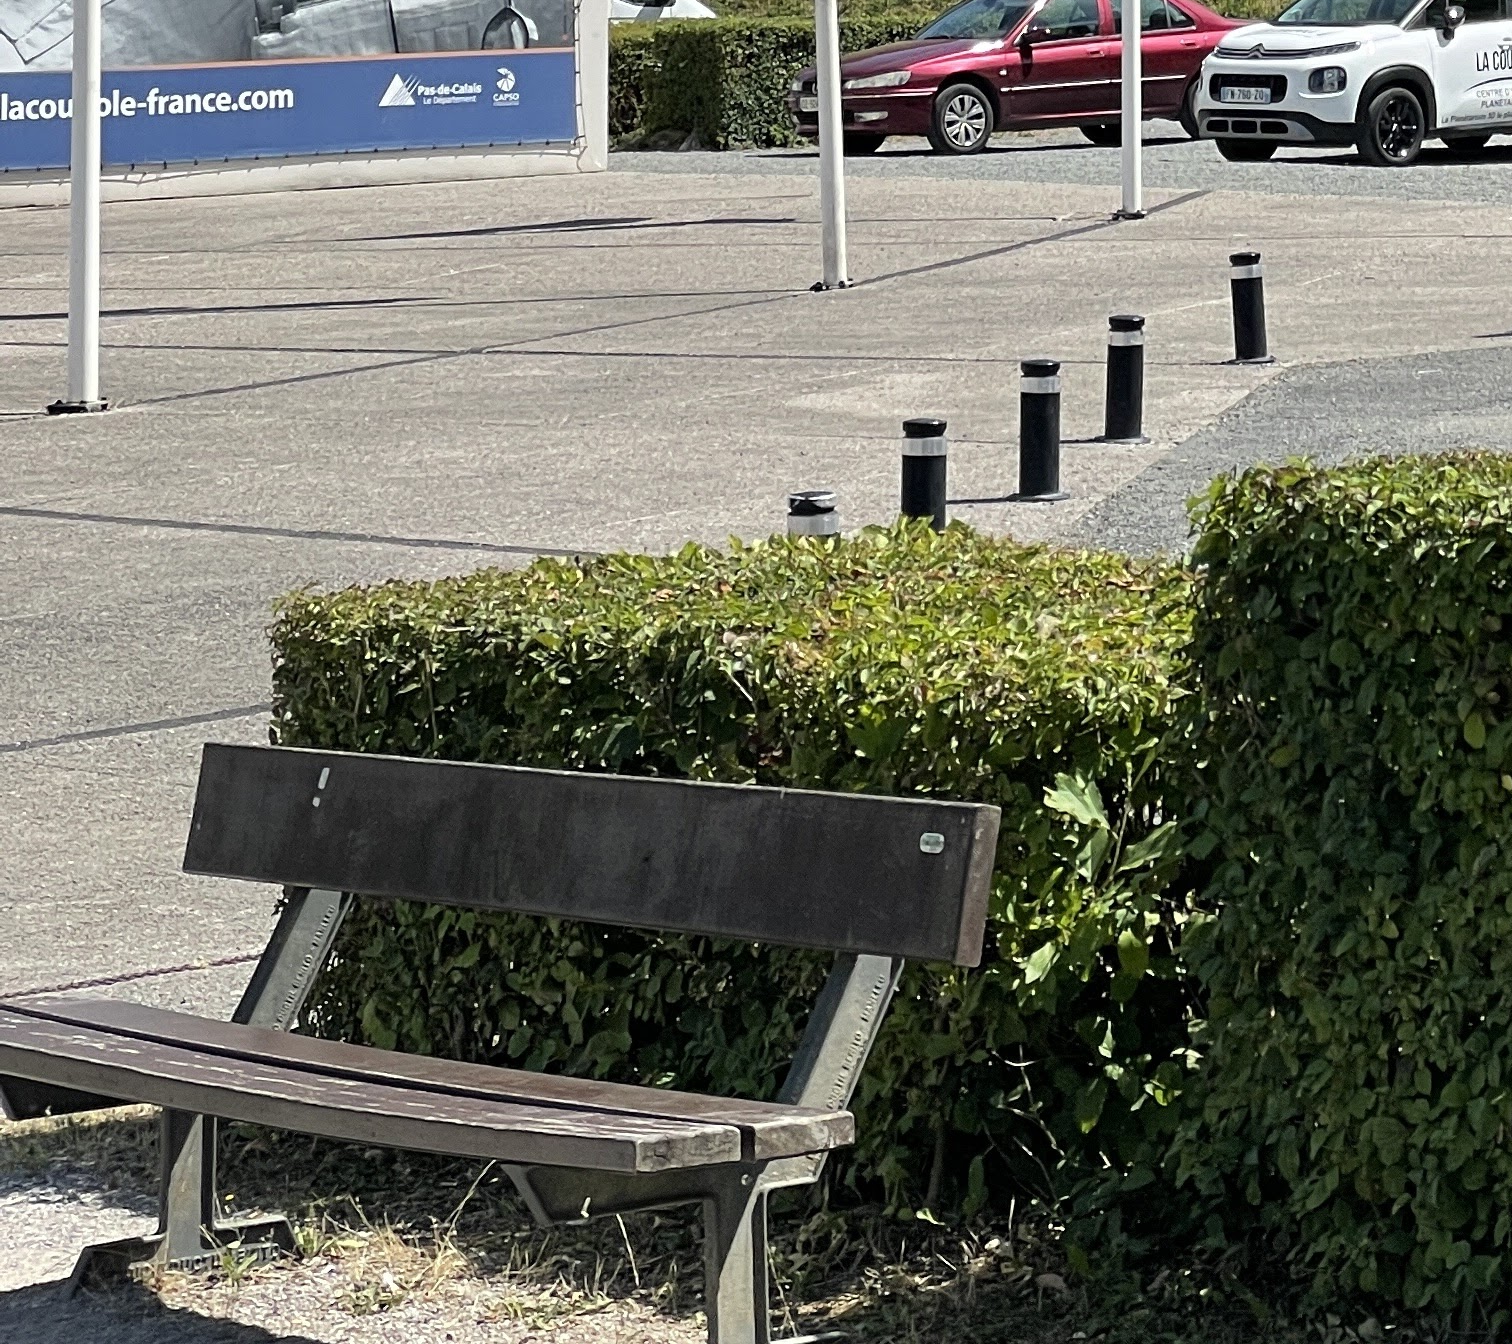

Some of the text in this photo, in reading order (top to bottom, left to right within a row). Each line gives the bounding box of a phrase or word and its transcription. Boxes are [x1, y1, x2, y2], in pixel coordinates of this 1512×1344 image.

[1476, 52, 1490, 72] LA
[417, 83, 482, 96] Pas-de-Calais
[1476, 88, 1503, 99] CENTRE
[0, 88, 294, 120] lacouole-france.com
[493, 93, 520, 102] CAPSO
